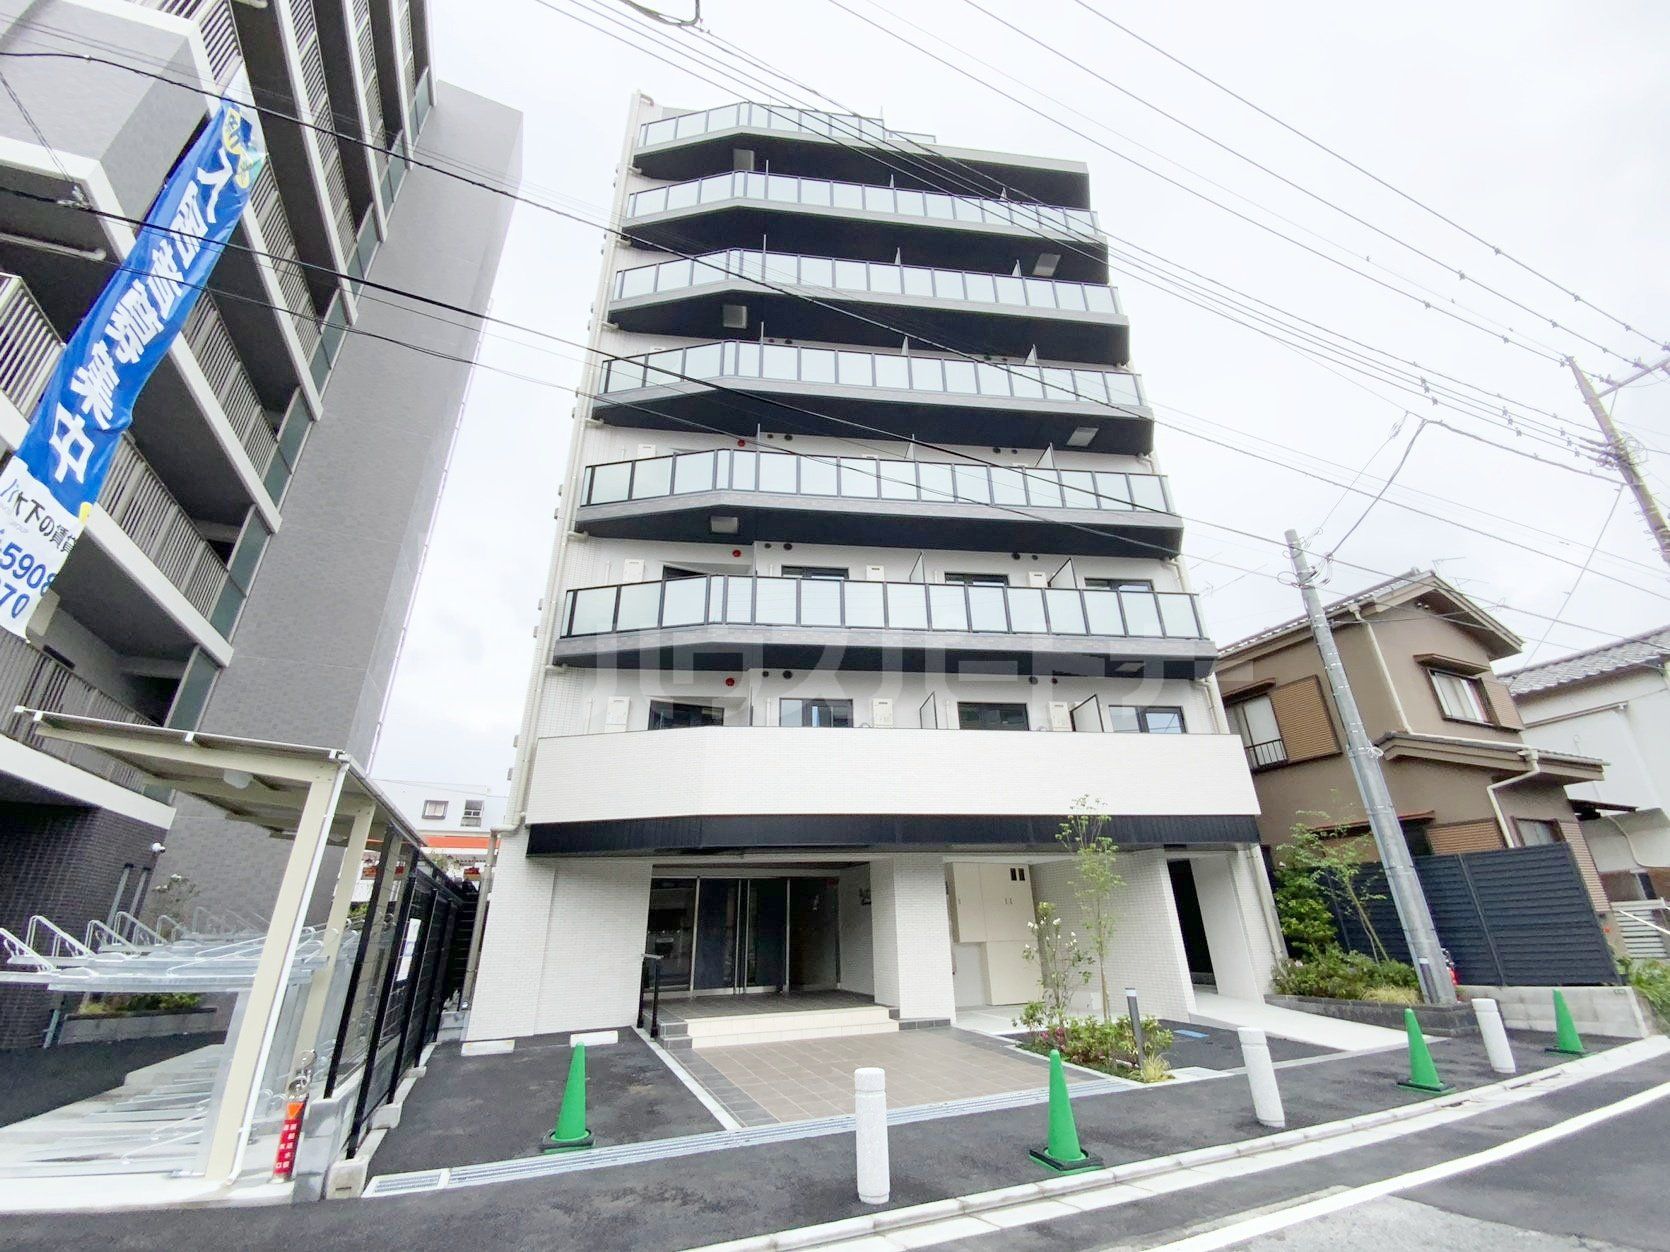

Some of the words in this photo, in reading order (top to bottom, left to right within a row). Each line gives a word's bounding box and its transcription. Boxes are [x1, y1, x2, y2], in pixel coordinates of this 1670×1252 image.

[48, 148, 233, 484] 入居者募集中
